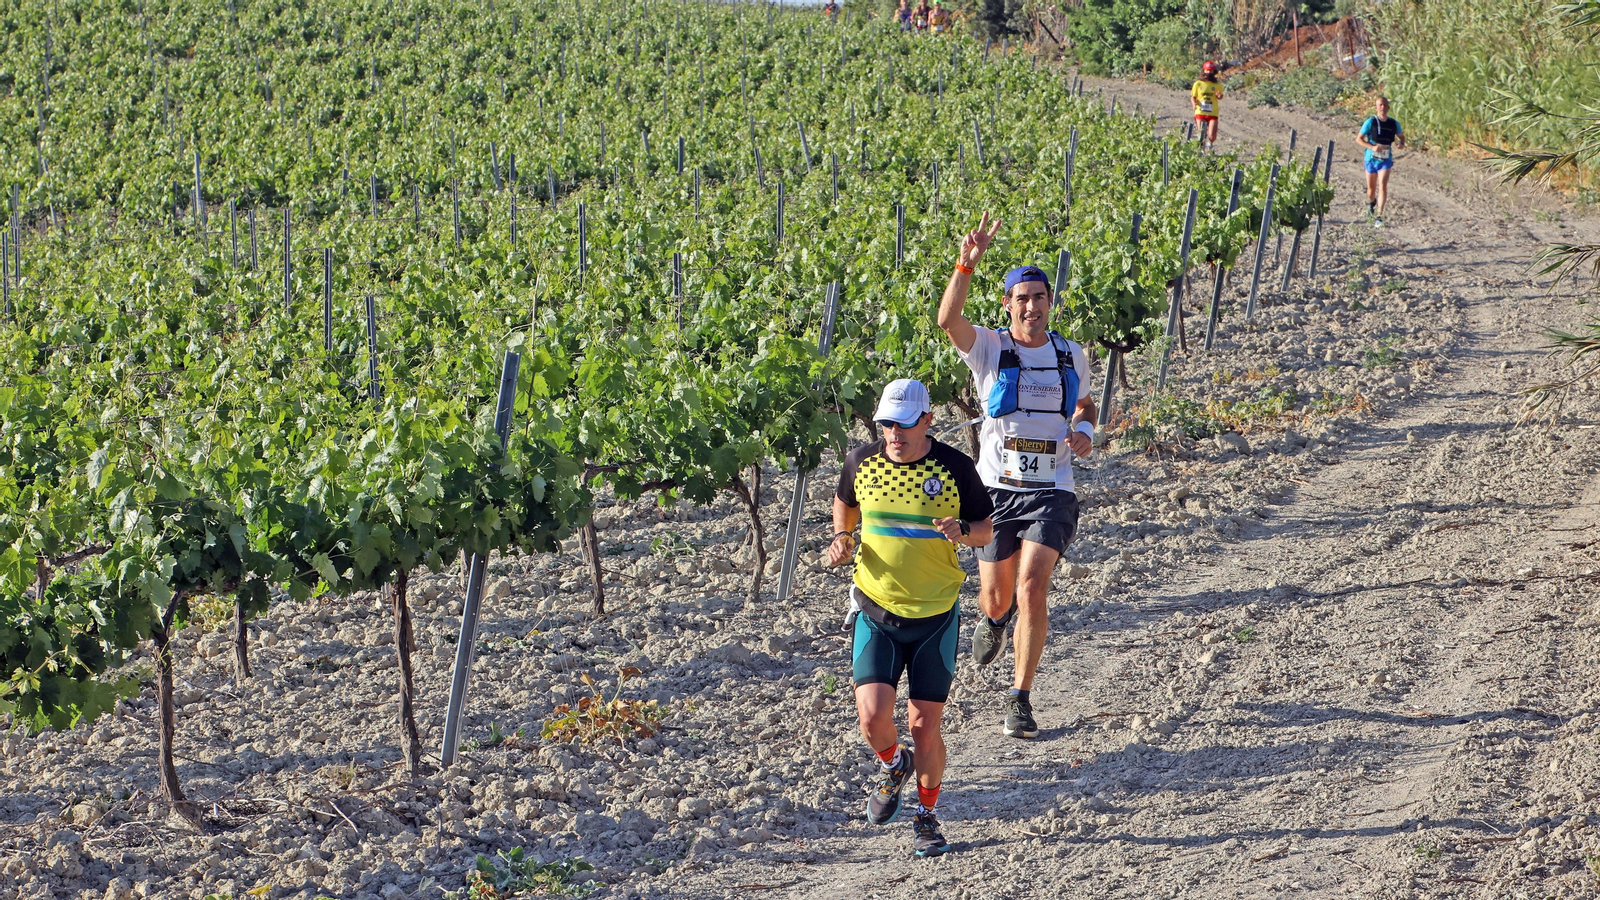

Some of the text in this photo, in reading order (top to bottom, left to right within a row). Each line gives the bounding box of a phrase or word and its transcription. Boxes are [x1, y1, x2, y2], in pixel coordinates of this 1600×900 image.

[1018, 384, 1061, 393] ONTESIERRA
[1018, 438, 1045, 451] Sherry
[1019, 455, 1039, 473] 34
